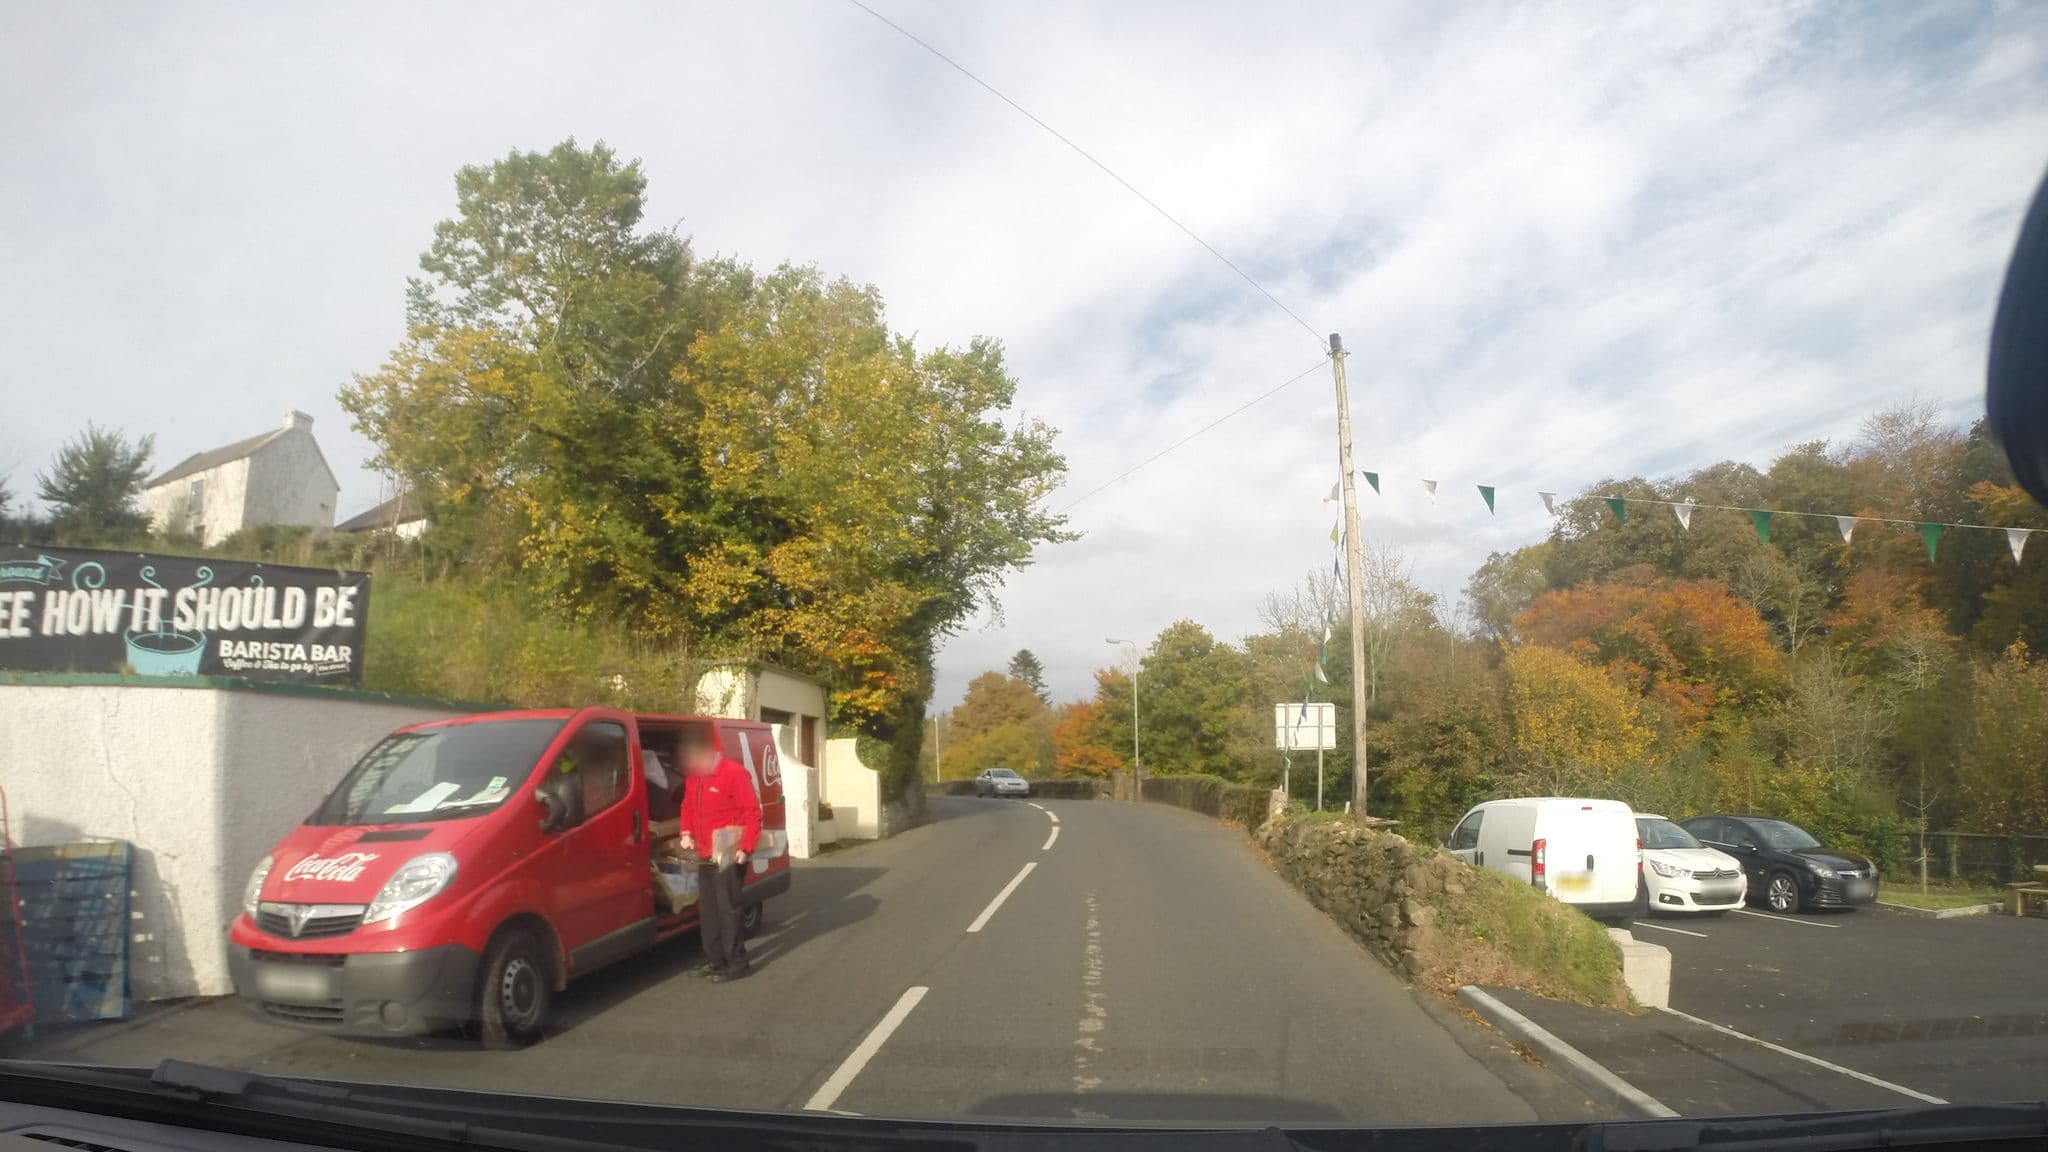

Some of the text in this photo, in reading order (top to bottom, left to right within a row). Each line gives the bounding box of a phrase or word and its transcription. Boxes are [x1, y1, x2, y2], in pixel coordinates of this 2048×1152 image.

[41, 588, 126, 636] HOW
[131, 587, 169, 633] IT
[174, 586, 307, 632] SHOULD
[313, 585, 358, 627] BE
[219, 639, 353, 663] BARISTA BAR
